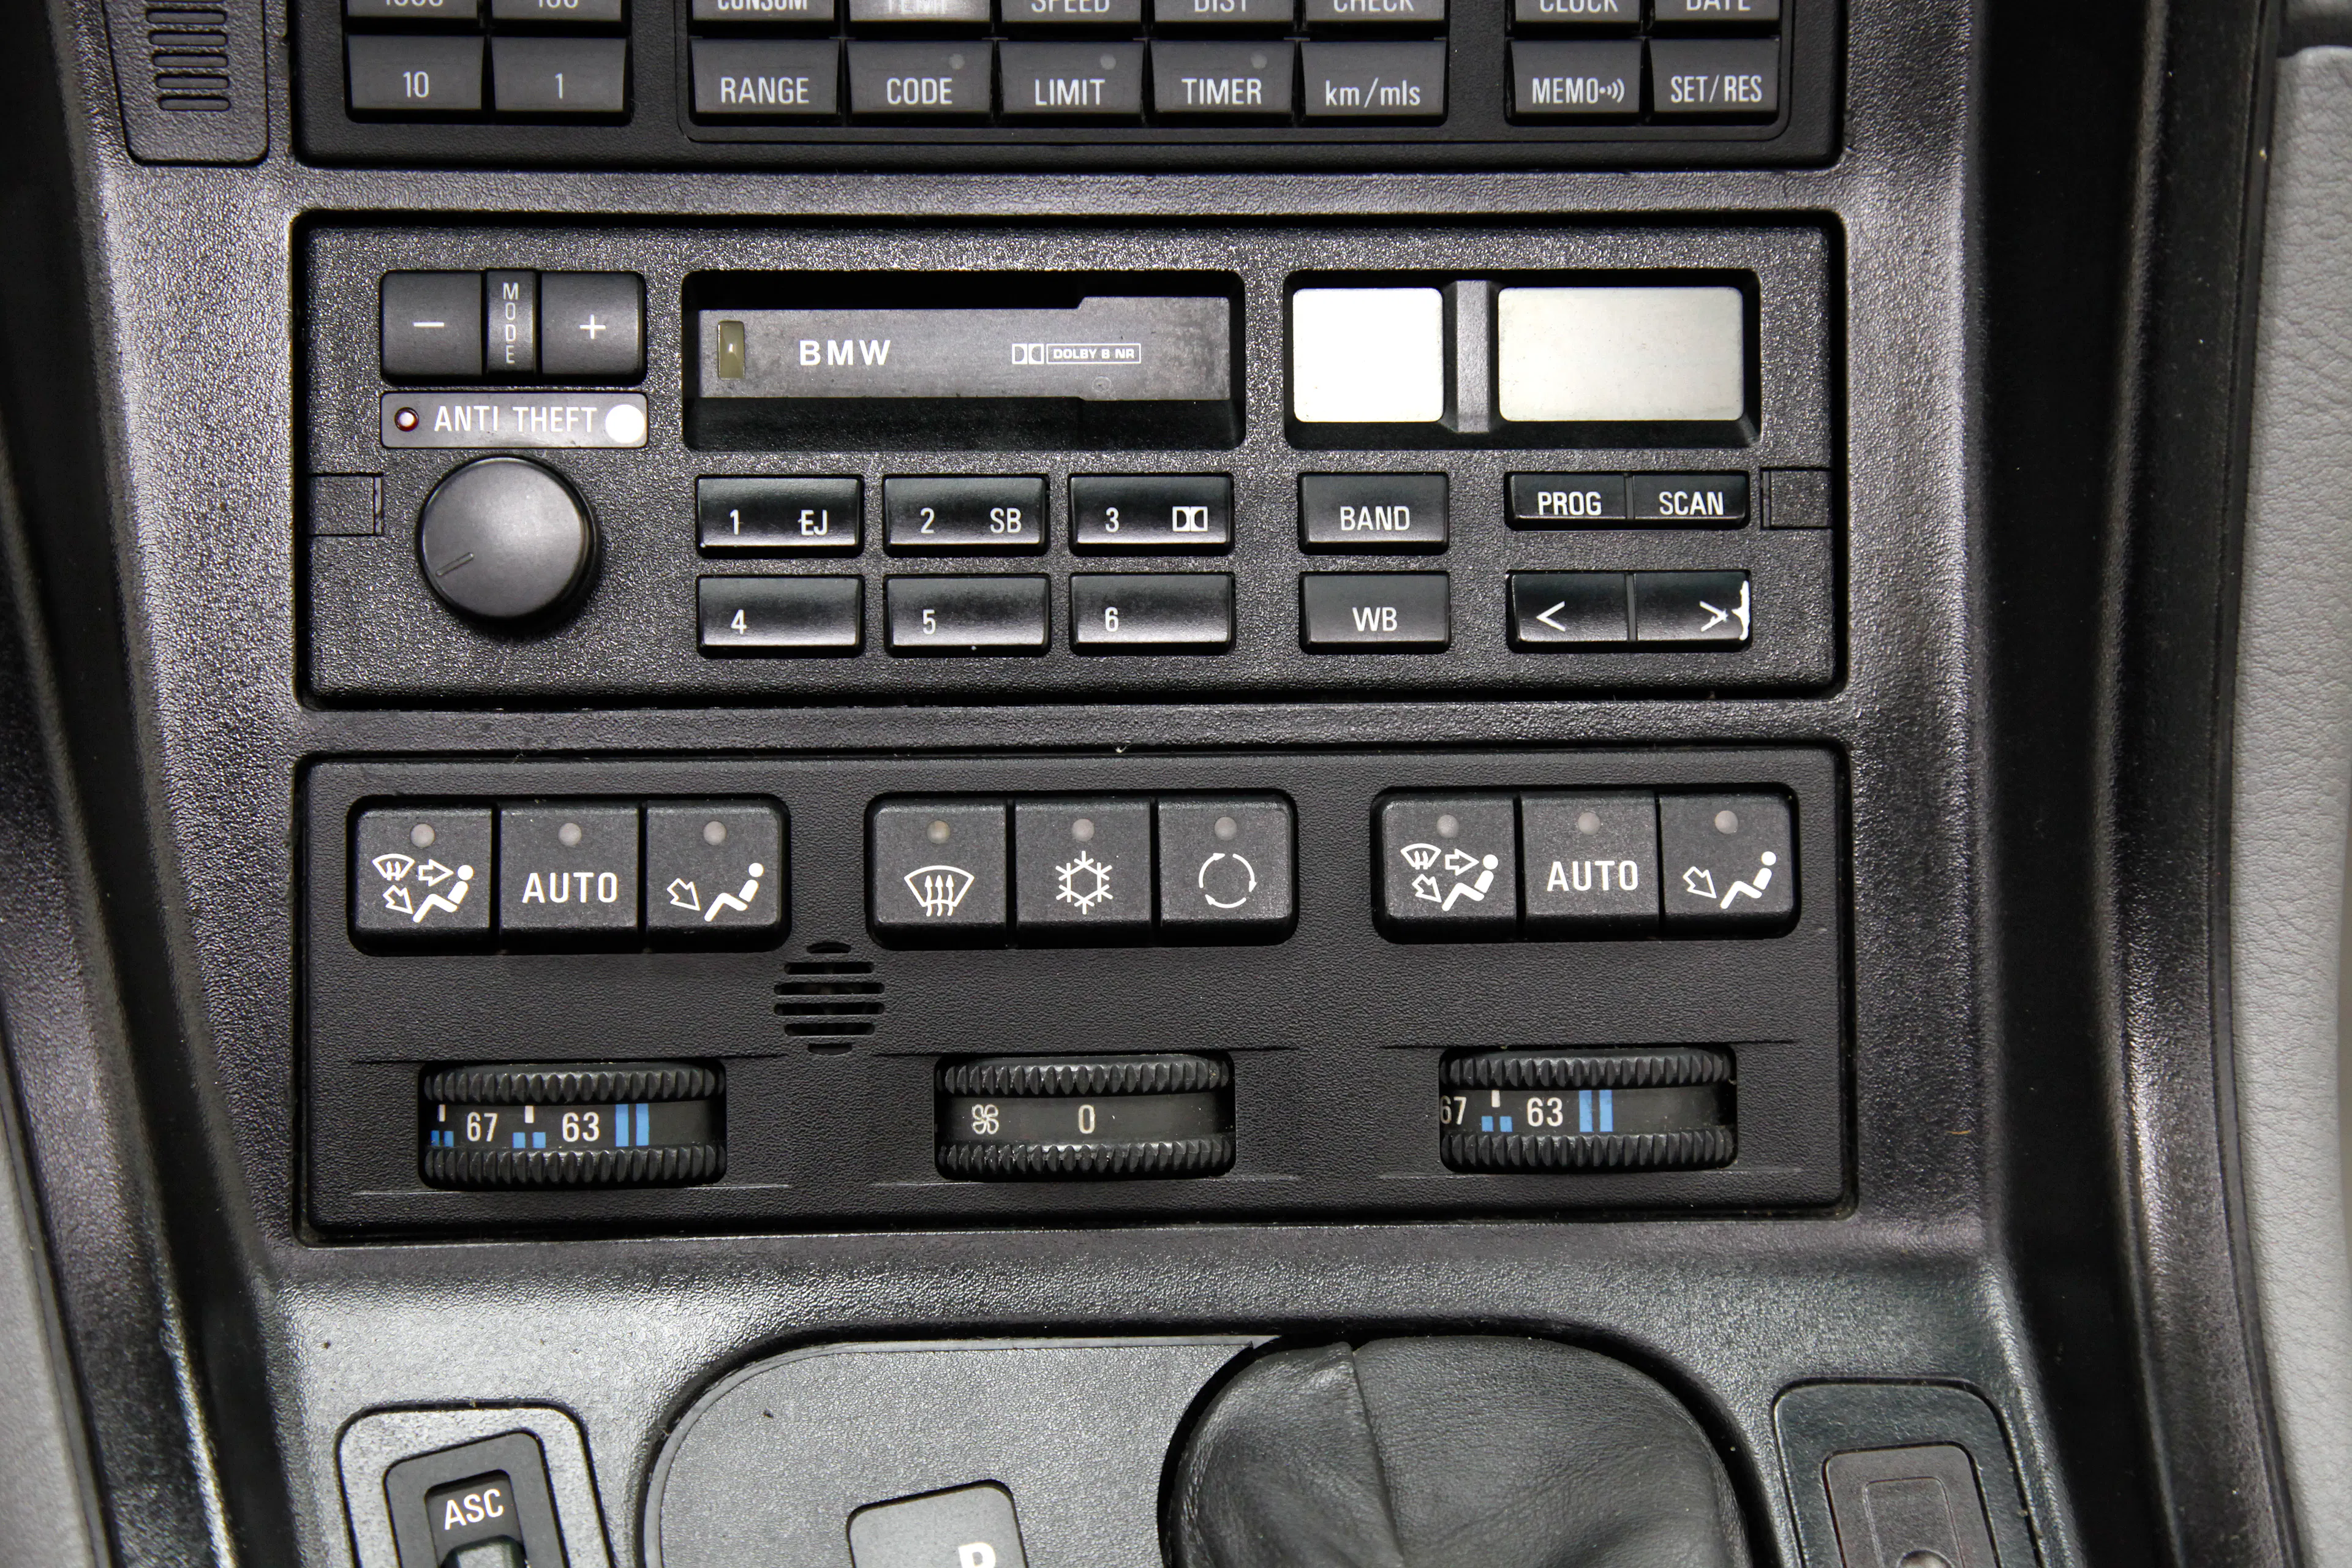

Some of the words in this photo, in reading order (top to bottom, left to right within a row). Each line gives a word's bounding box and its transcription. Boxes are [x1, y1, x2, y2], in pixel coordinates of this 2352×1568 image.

[403, 71, 429, 98] 10
[555, 73, 563, 99] 1
[720, 77, 809, 104] RANGE
[886, 77, 952, 105] CODE
[1035, 78, 1106, 106] LIMIT
[1181, 78, 1262, 105] TIMER
[1325, 77, 1420, 108] km/mls
[1532, 77, 1599, 104] MEMO
[1670, 75, 1762, 103] SET/RES
[501, 282, 519, 364] MODE
[799, 339, 891, 366] BMW
[1053, 348, 1097, 360] DOLBY
[1101, 349, 1110, 359] B
[1114, 348, 1135, 360] NR
[434, 405, 499, 432] ANTI
[512, 406, 598, 432] THEFT
[1538, 491, 1602, 516] PROG
[1659, 491, 1724, 516] SCAN
[729, 509, 739, 535] 1
[799, 510, 829, 536] EJ
[919, 507, 935, 533] 2
[989, 507, 1022, 533] SB
[1105, 507, 1119, 533] 3
[1340, 506, 1411, 532] BAND
[731, 609, 747, 635] 4
[922, 609, 937, 635] 5
[1104, 606, 1119, 633] 6
[1352, 607, 1398, 632] WB
[522, 872, 617, 903] AUTO
[1547, 860, 1638, 892] AUTO
[1439, 1096, 1468, 1125] 67
[1527, 1097, 1563, 1127] 63
[467, 1112, 498, 1142] 67
[562, 1112, 600, 1142] 63
[444, 1488, 504, 1531] ASC
